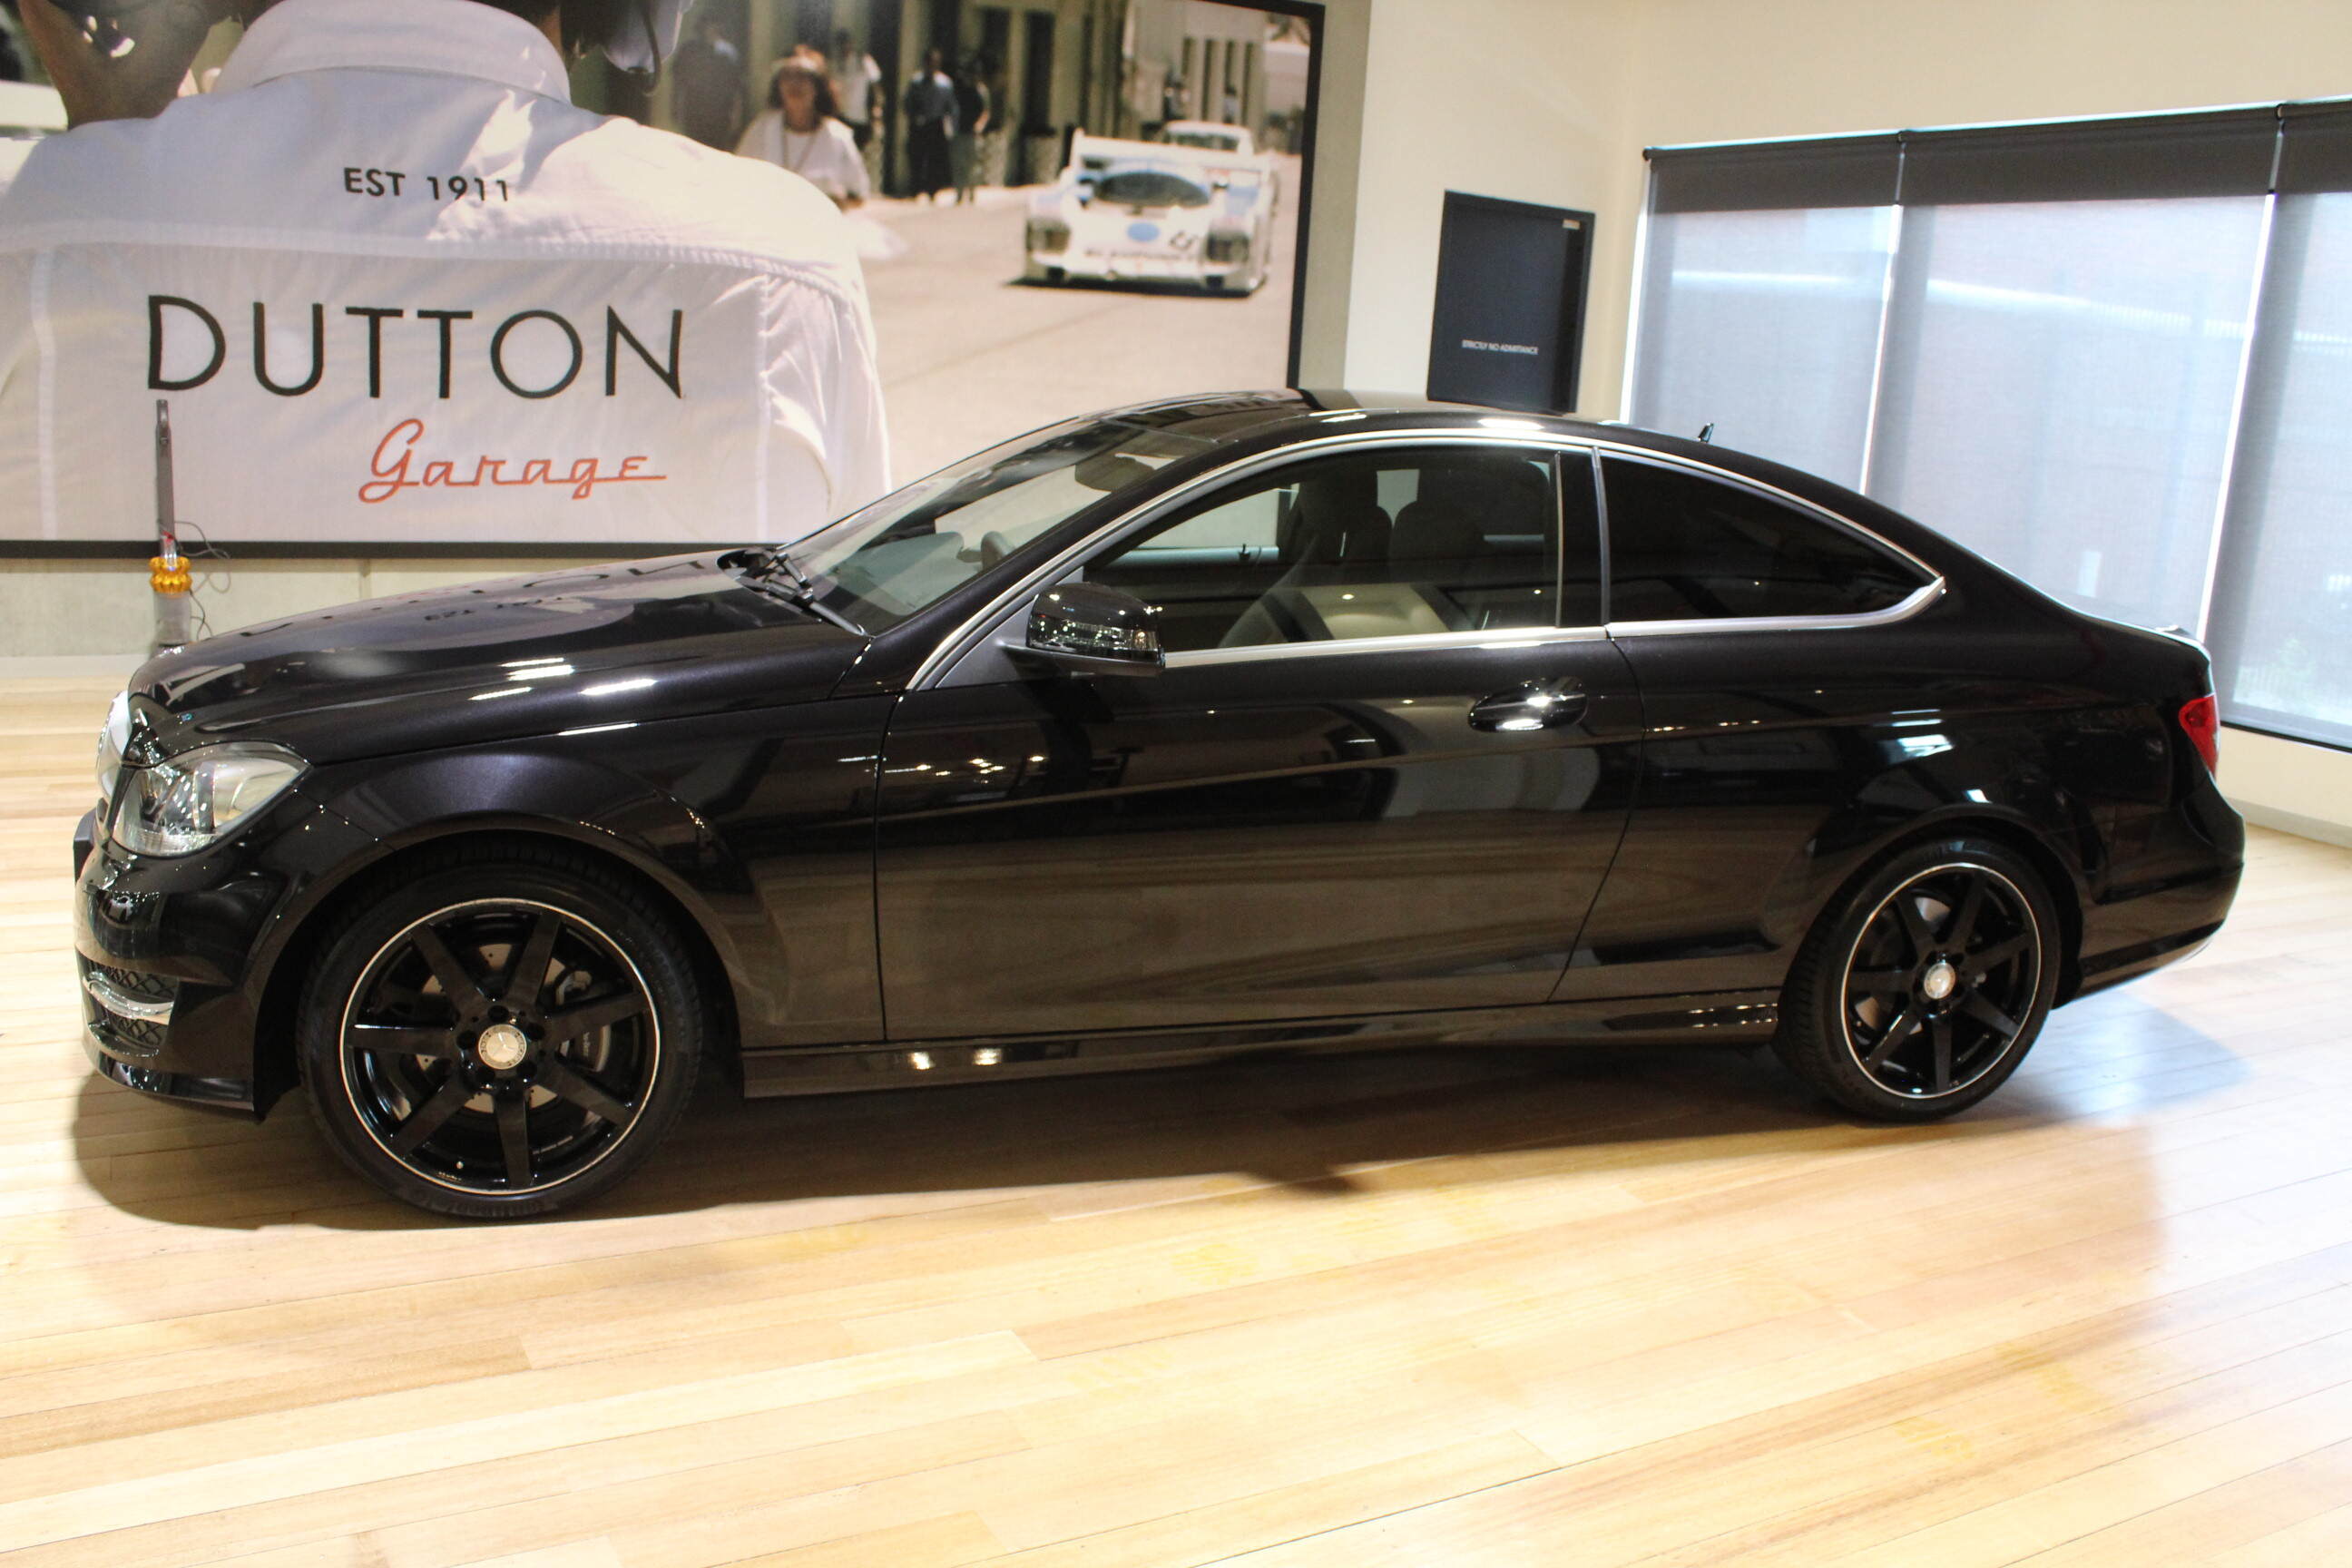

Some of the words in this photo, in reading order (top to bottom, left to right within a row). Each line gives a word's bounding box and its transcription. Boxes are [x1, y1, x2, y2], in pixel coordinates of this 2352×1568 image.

[343, 166, 406, 197] EST
[426, 175, 508, 201] 1911
[148, 294, 683, 399] DUTTON
[358, 418, 667, 504] Garage
